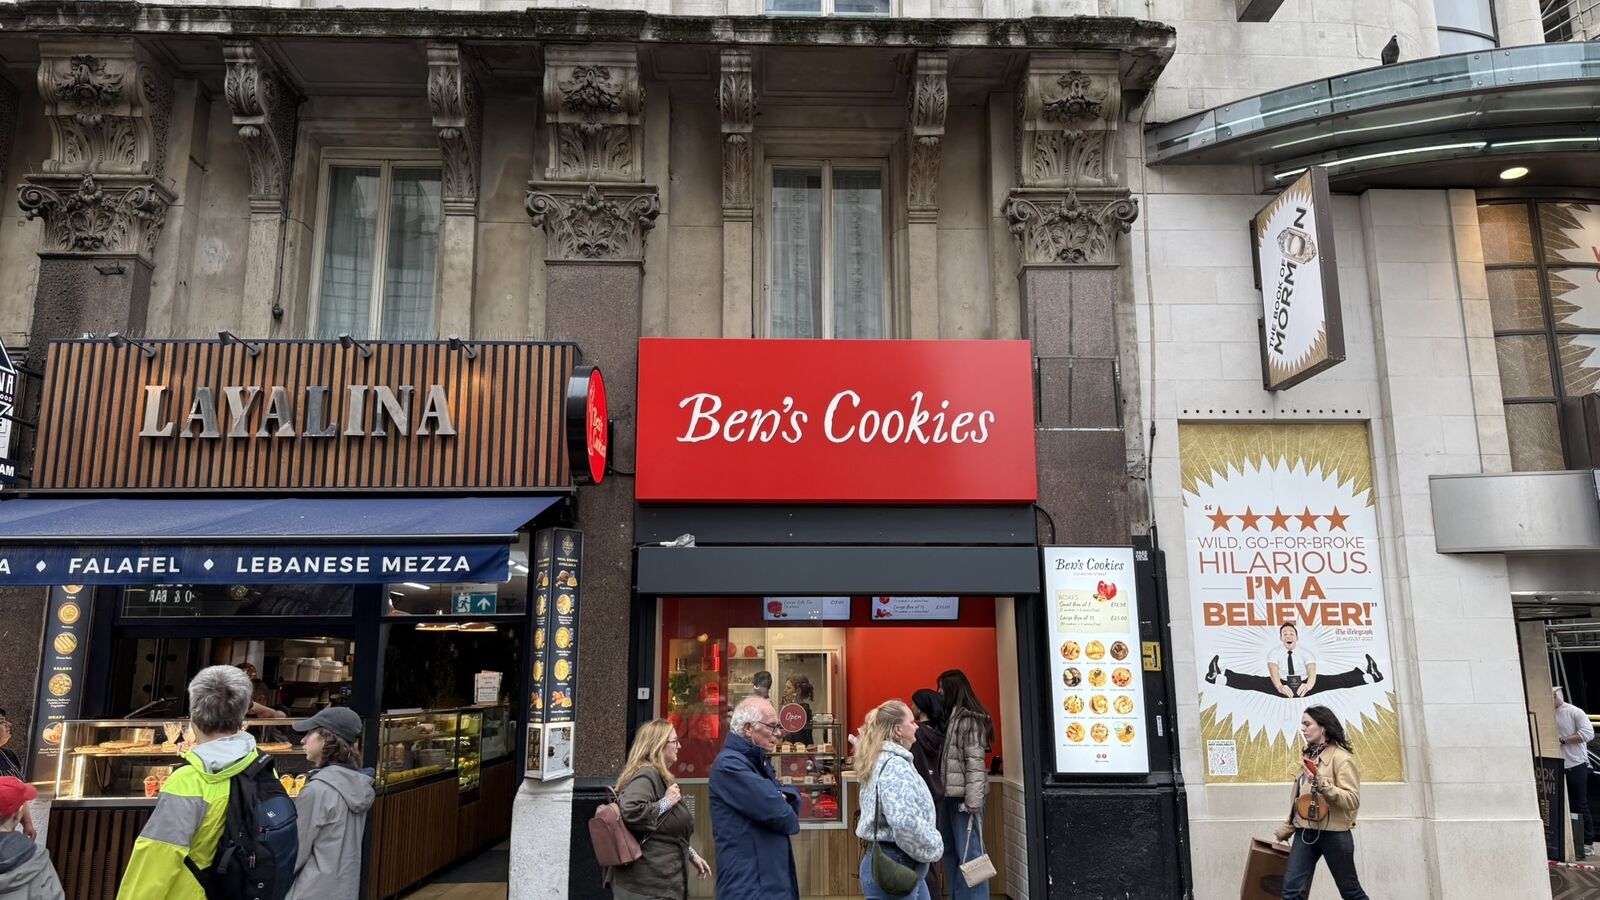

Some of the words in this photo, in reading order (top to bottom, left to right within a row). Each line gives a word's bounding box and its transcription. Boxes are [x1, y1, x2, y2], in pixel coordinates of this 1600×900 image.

[1268, 324, 1277, 348] THE
[1273, 282, 1283, 319] BOOK
[1280, 258, 1286, 278] OF
[139, 384, 457, 438] LAYALINA
[676, 391, 809, 444] Ben's
[823, 389, 995, 445] Cookies
[1198, 536, 1242, 550] WILD,
[1245, 536, 1365, 549] GO-FOR-BROKE
[68, 557, 181, 574] FALAFEL
[236, 556, 370, 573] LEBANESE
[381, 555, 471, 572] MEZZA
[1055, 558, 1084, 571] Ben's
[1086, 557, 1125, 571] Cookies
[1199, 551, 1372, 574] HILARIOUS.
[1300, 575, 1327, 600] A
[785, 711, 802, 723] Open
[1535, 767, 1556, 781] OOK
